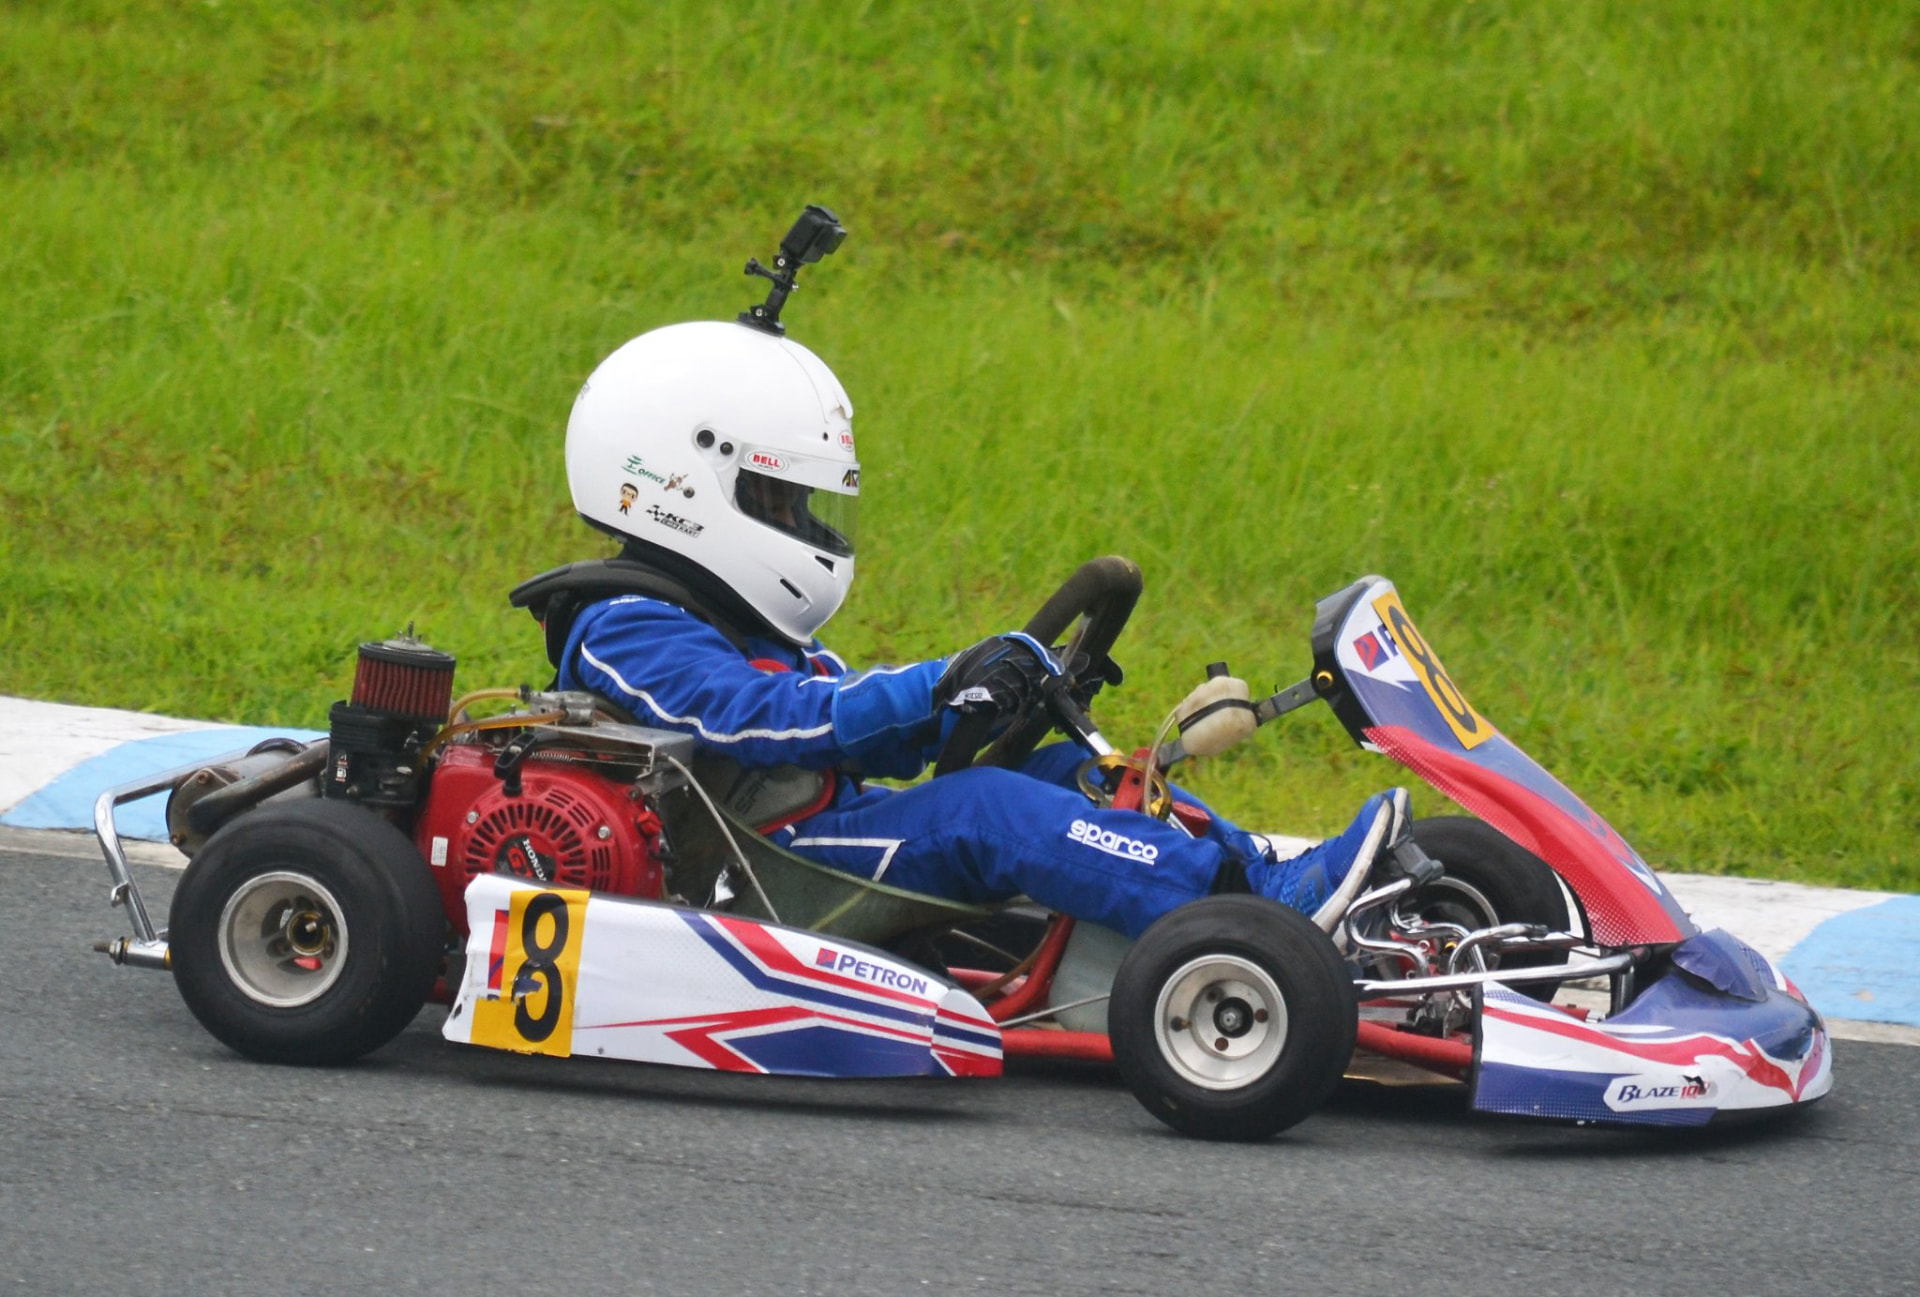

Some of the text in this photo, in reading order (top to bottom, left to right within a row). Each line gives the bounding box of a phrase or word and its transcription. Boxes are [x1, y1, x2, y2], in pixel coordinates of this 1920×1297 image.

[753, 454, 780, 468] BELL
[1388, 605, 1478, 734] 8
[1070, 819, 1159, 862] sparco
[511, 893, 569, 1043] 8
[838, 954, 928, 994] PETRON
